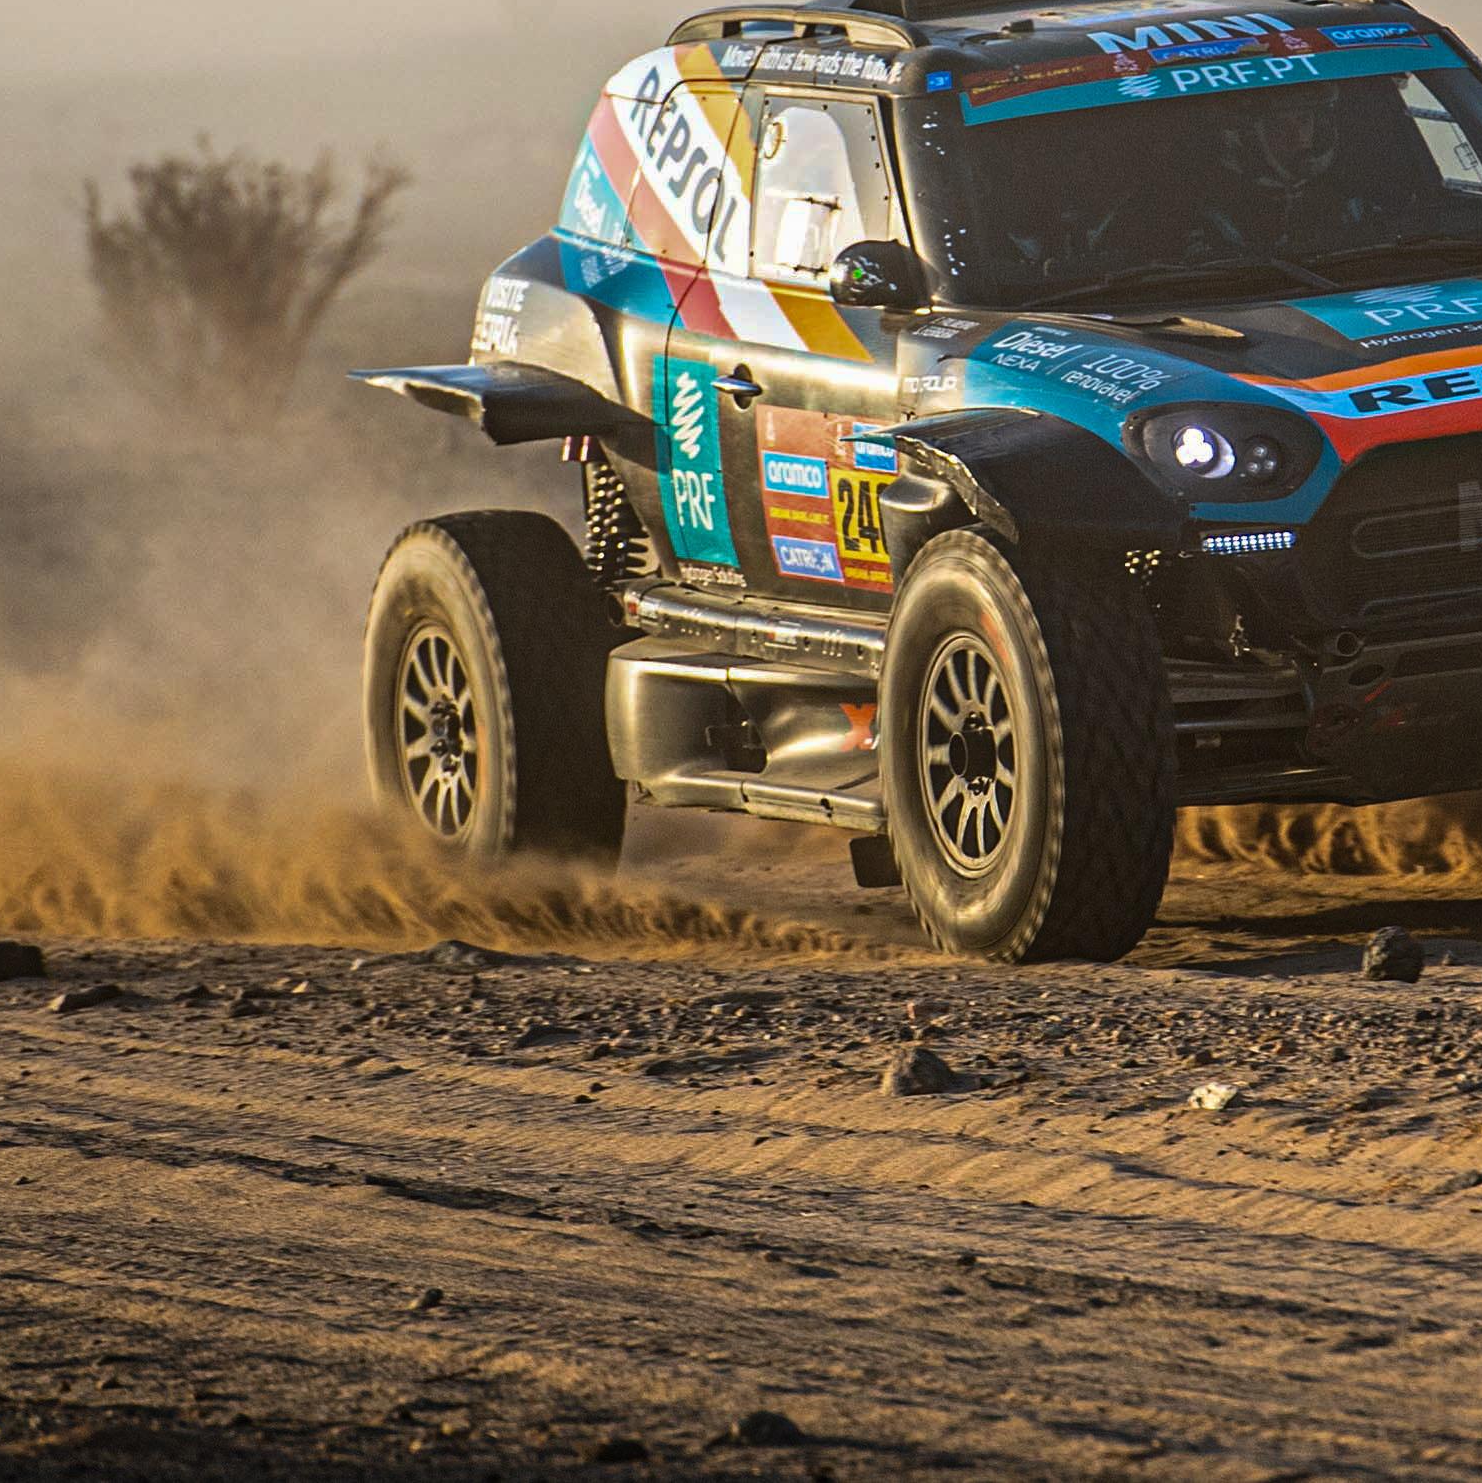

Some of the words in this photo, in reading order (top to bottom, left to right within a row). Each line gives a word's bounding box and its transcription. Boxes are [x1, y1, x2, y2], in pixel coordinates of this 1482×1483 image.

[1087, 13, 1294, 54] MINI
[1170, 53, 1319, 92] PRF.PT
[630, 66, 738, 262] REPSOL
[992, 331, 1083, 359] Diesel
[1359, 326, 1461, 349] Hydrogen
[992, 352, 1042, 372] NEXA
[1081, 353, 1172, 391] 100%
[769, 460, 822, 489] aramco
[672, 468, 716, 531] PRF
